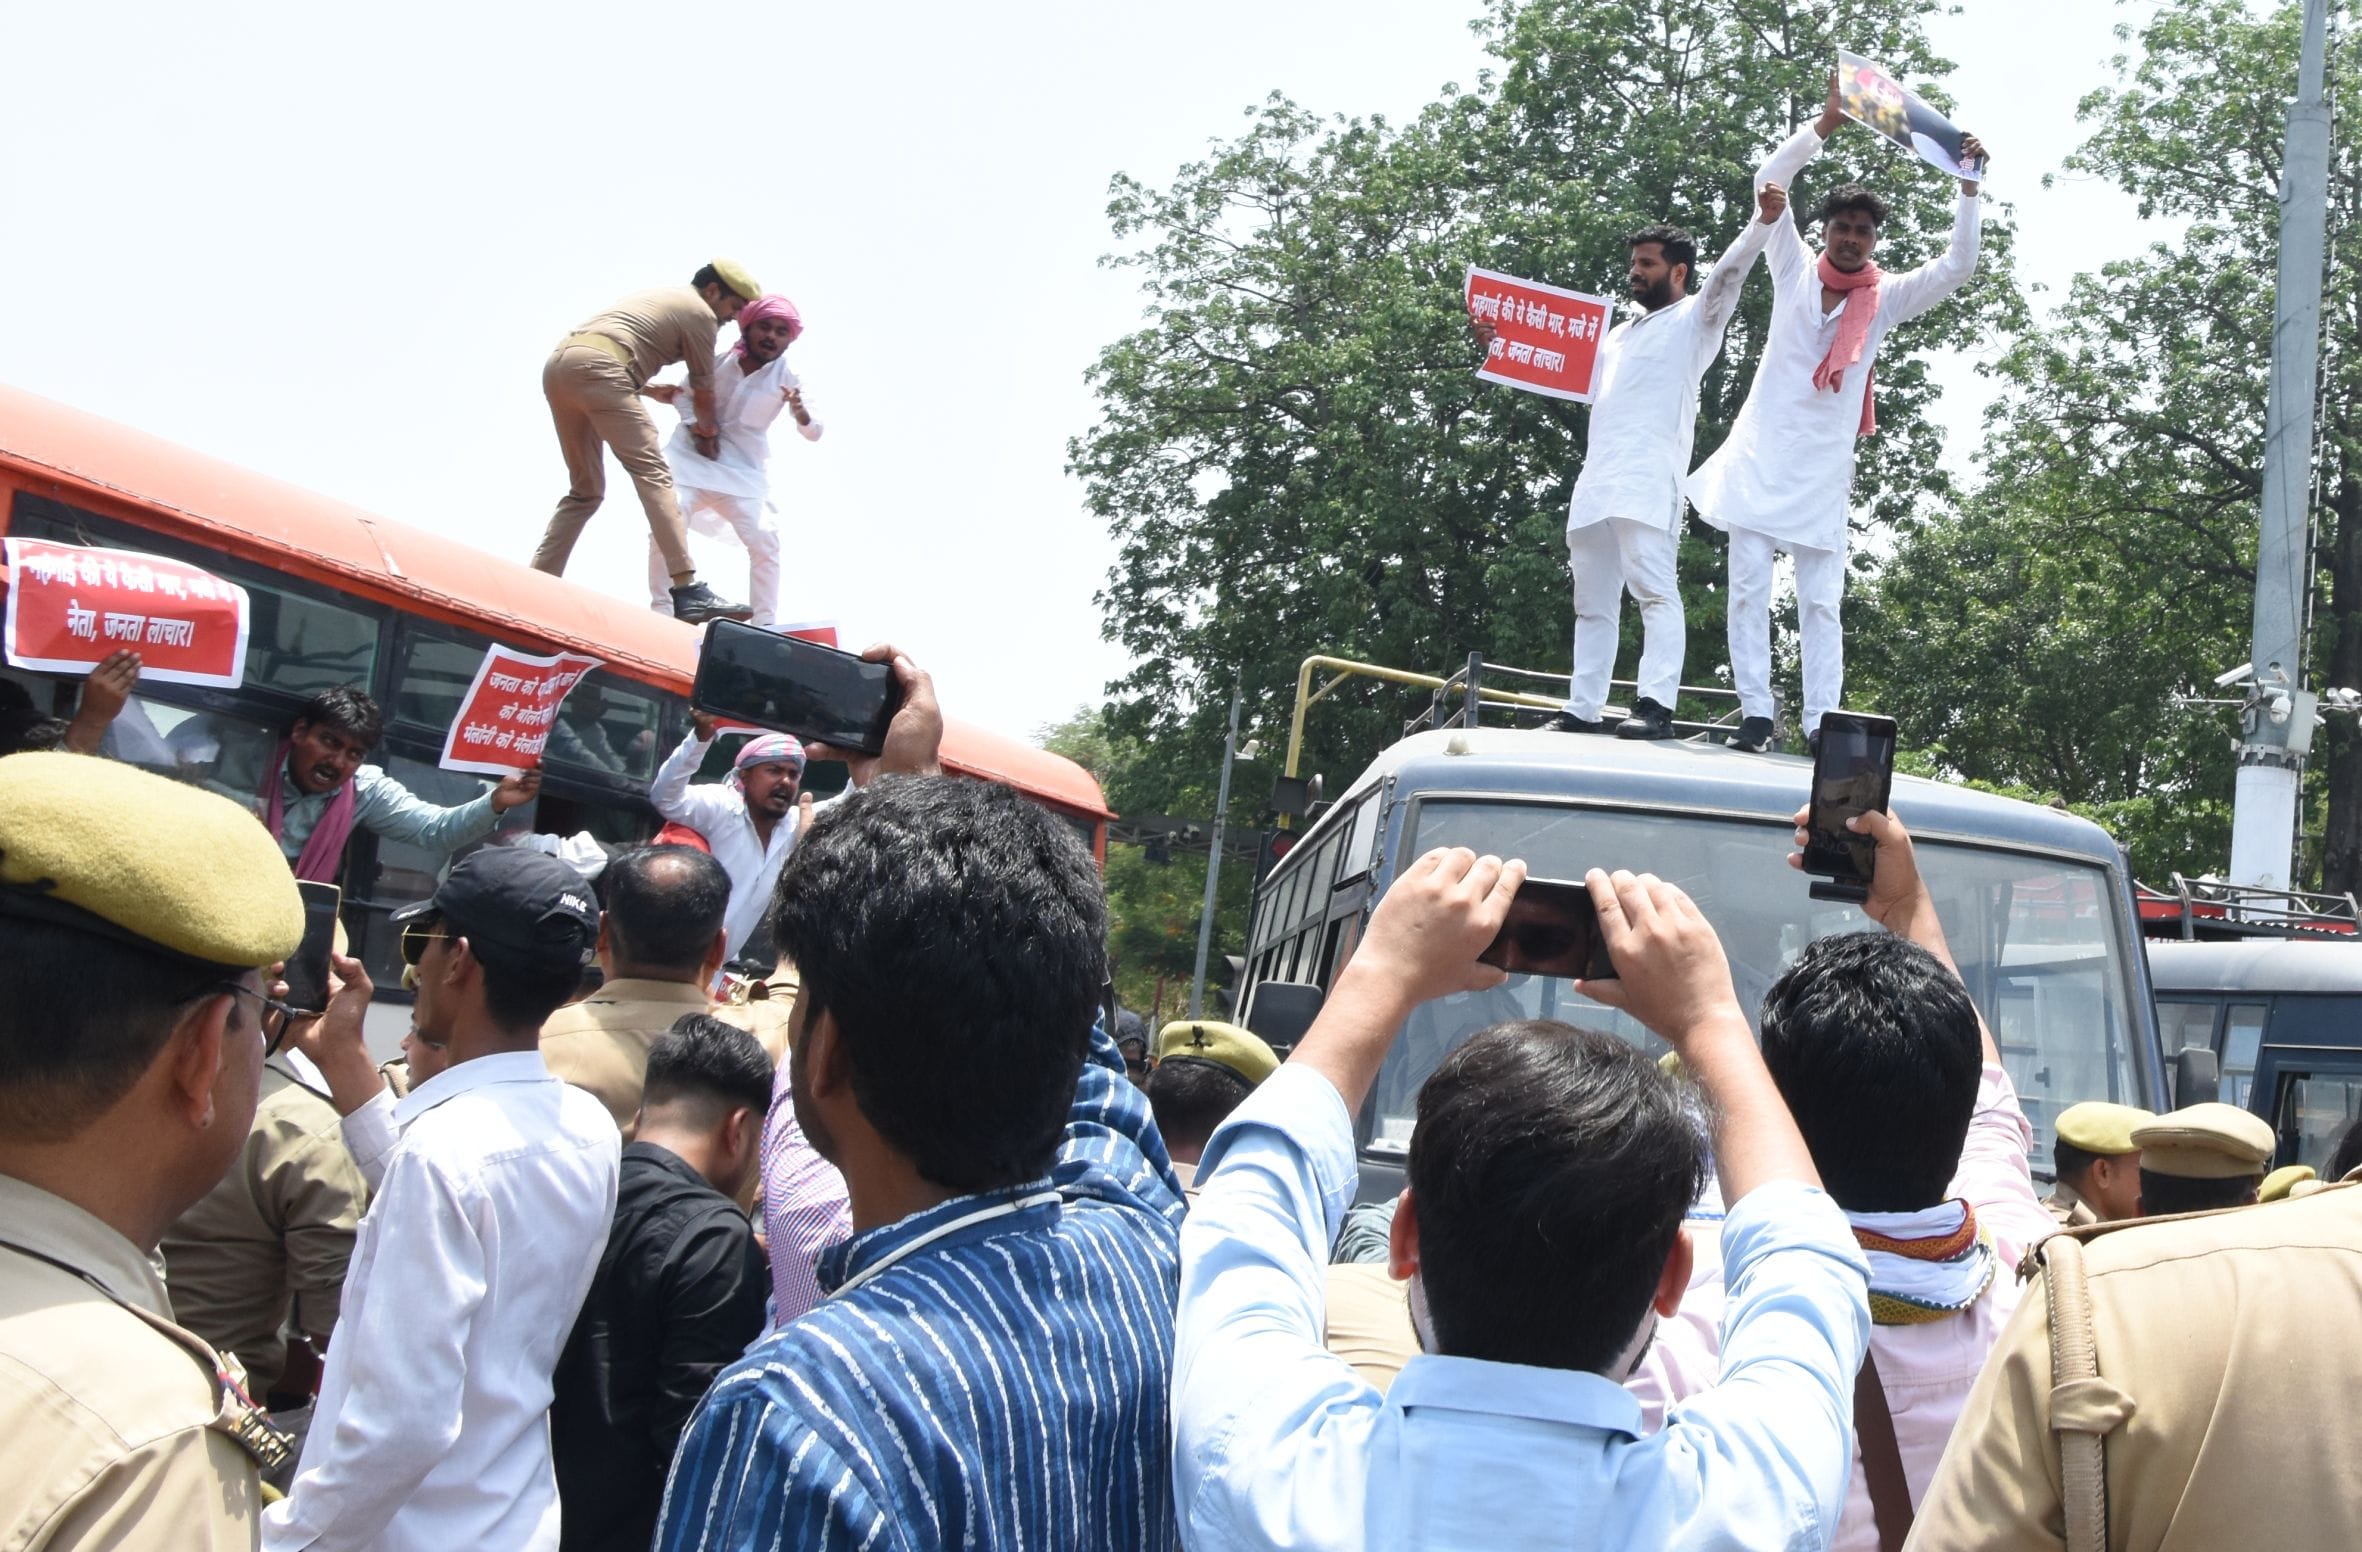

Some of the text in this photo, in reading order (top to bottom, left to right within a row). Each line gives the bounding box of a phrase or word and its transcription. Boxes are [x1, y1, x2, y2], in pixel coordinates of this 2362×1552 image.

[1472, 292, 1501, 320] महंगाई
[1501, 296, 1515, 322] की
[1516, 299, 1525, 325] ये
[1526, 301, 1547, 331] कैसी
[1568, 313, 1587, 341] मजे
[1508, 340, 1534, 365] जनता
[66, 599, 98, 643] नेता,
[104, 611, 146, 641] जनता
[489, 671, 523, 693] जनता
[521, 676, 540, 696] को
[499, 702, 519, 720] को
[496, 730, 515, 749] को
[560, 892, 587, 913] NIKE
